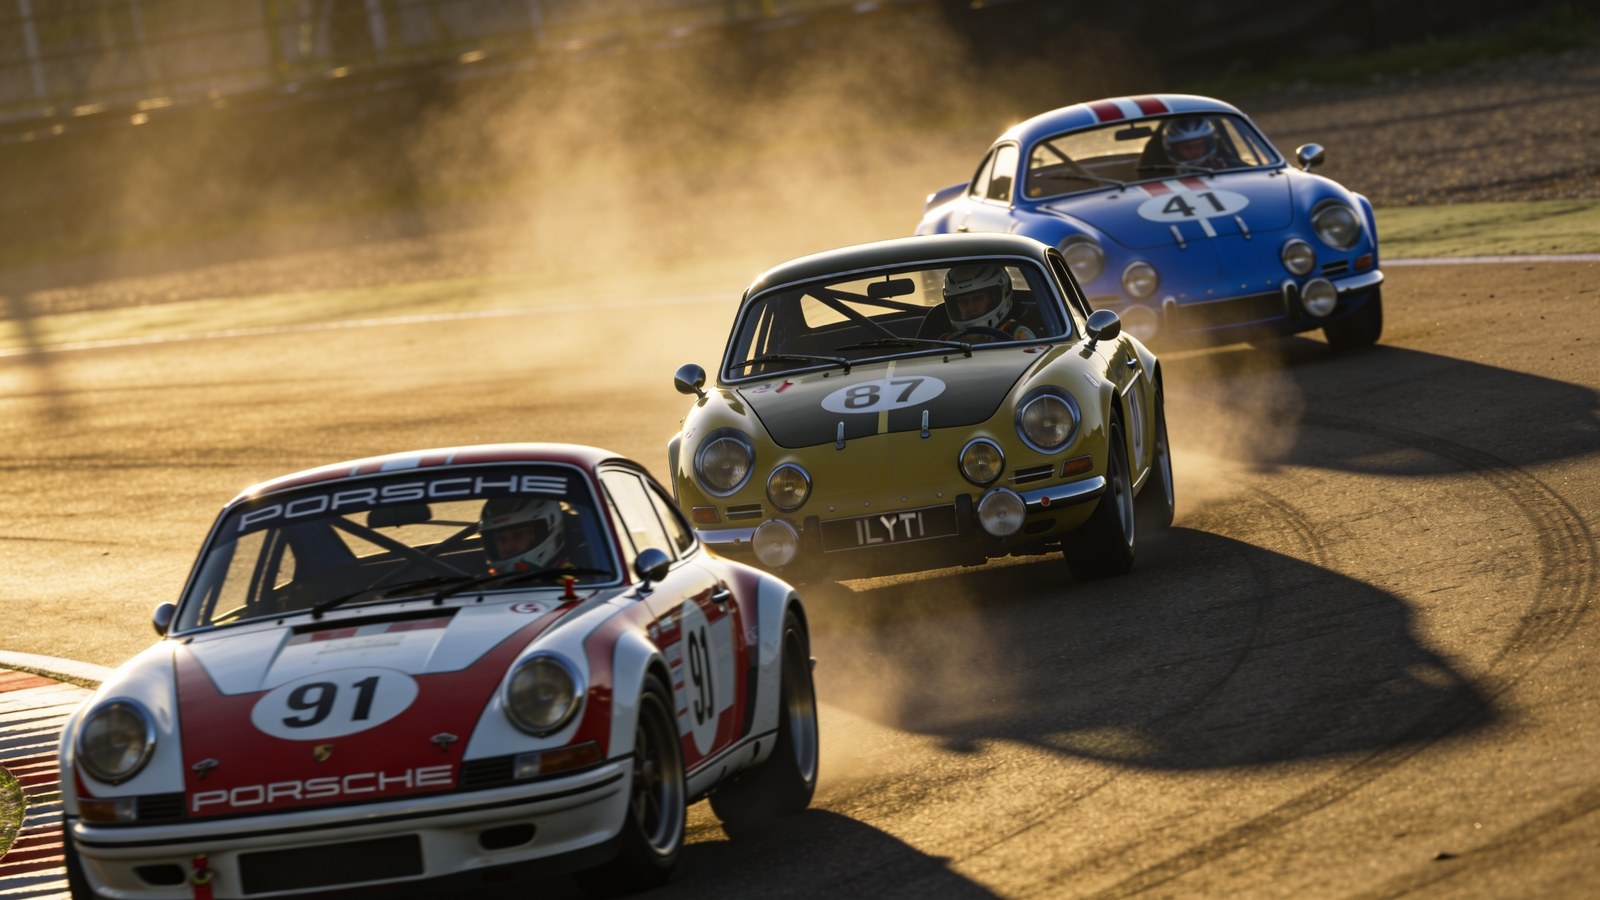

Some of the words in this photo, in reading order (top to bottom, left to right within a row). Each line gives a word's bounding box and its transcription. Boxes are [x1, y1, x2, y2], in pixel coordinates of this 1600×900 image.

[1162, 192, 1226, 217] 41
[844, 378, 925, 409] 87
[238, 475, 568, 532] PORSCHE
[687, 624, 713, 726] 91
[282, 676, 381, 728] 91
[192, 764, 453, 812] PORSCHE
